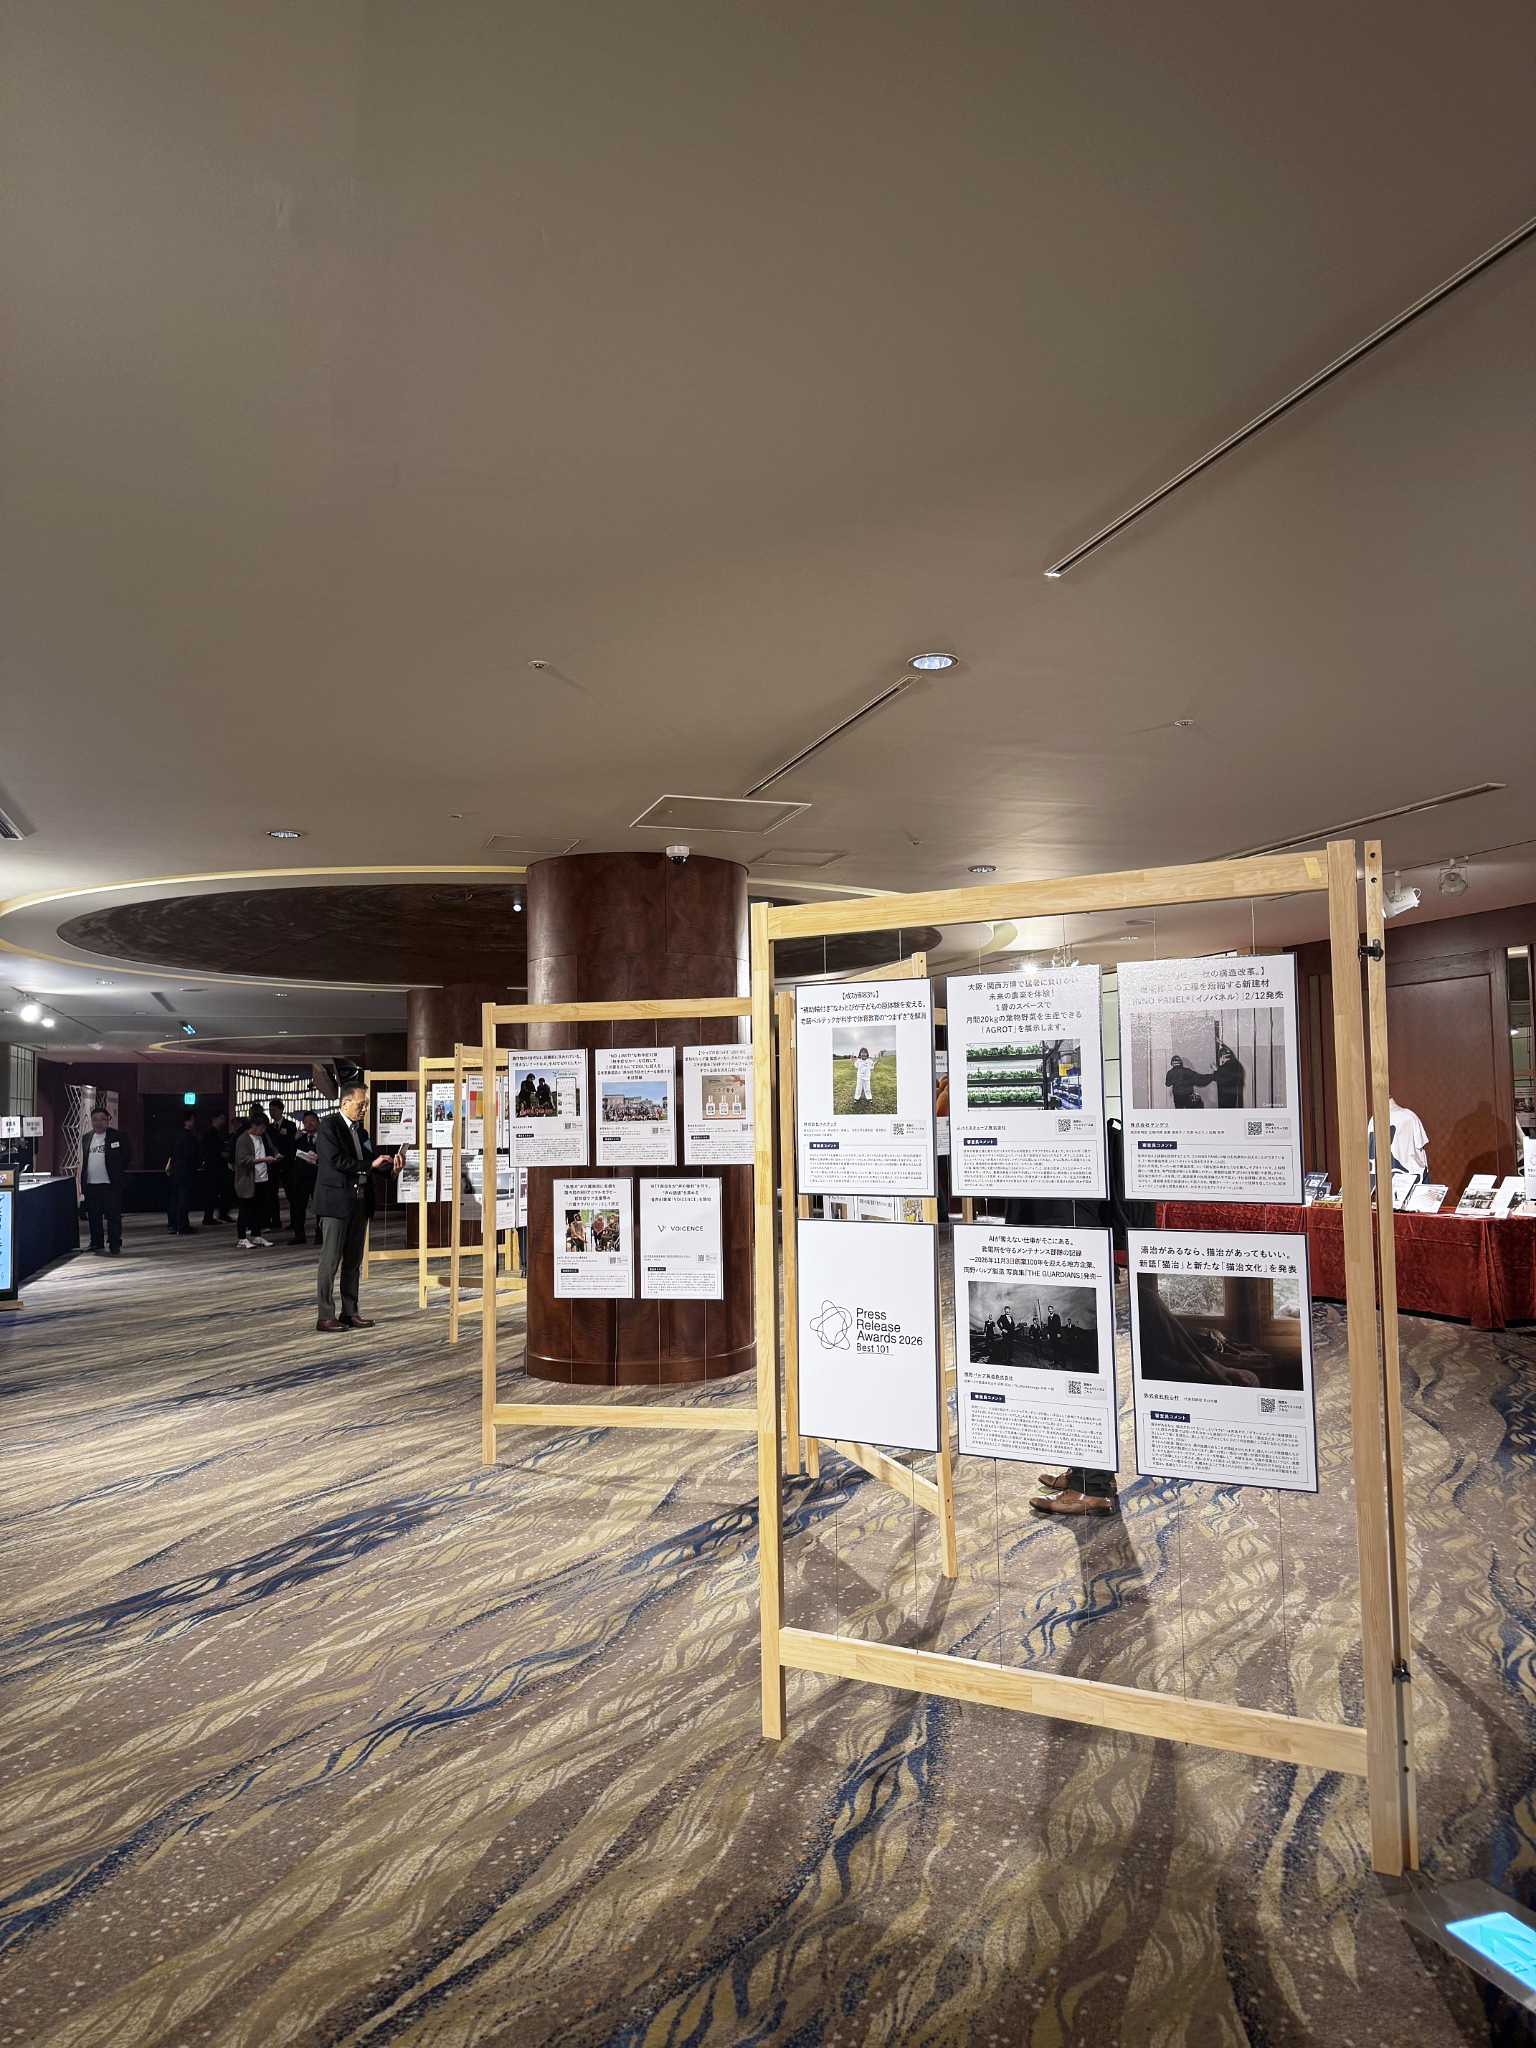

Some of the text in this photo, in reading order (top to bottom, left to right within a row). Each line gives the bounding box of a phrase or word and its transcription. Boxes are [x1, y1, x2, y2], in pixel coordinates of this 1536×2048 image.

[966, 1011, 1082, 1024] 月間20kgの葉物野菜を生産できる
[989, 1235, 1074, 1245] AIが奪えない仕事がそこにある。
[1141, 1246, 1291, 1260] 湯治があるなら、猫治があってもいい。
[1139, 1259, 1298, 1274] 新語「猫治」と新たな「猫治文化」を発表
[856, 1308, 887, 1320] Press
[856, 1319, 901, 1333] Release
[857, 1330, 923, 1346] Awards 2026
[857, 1343, 889, 1353] Best 101
